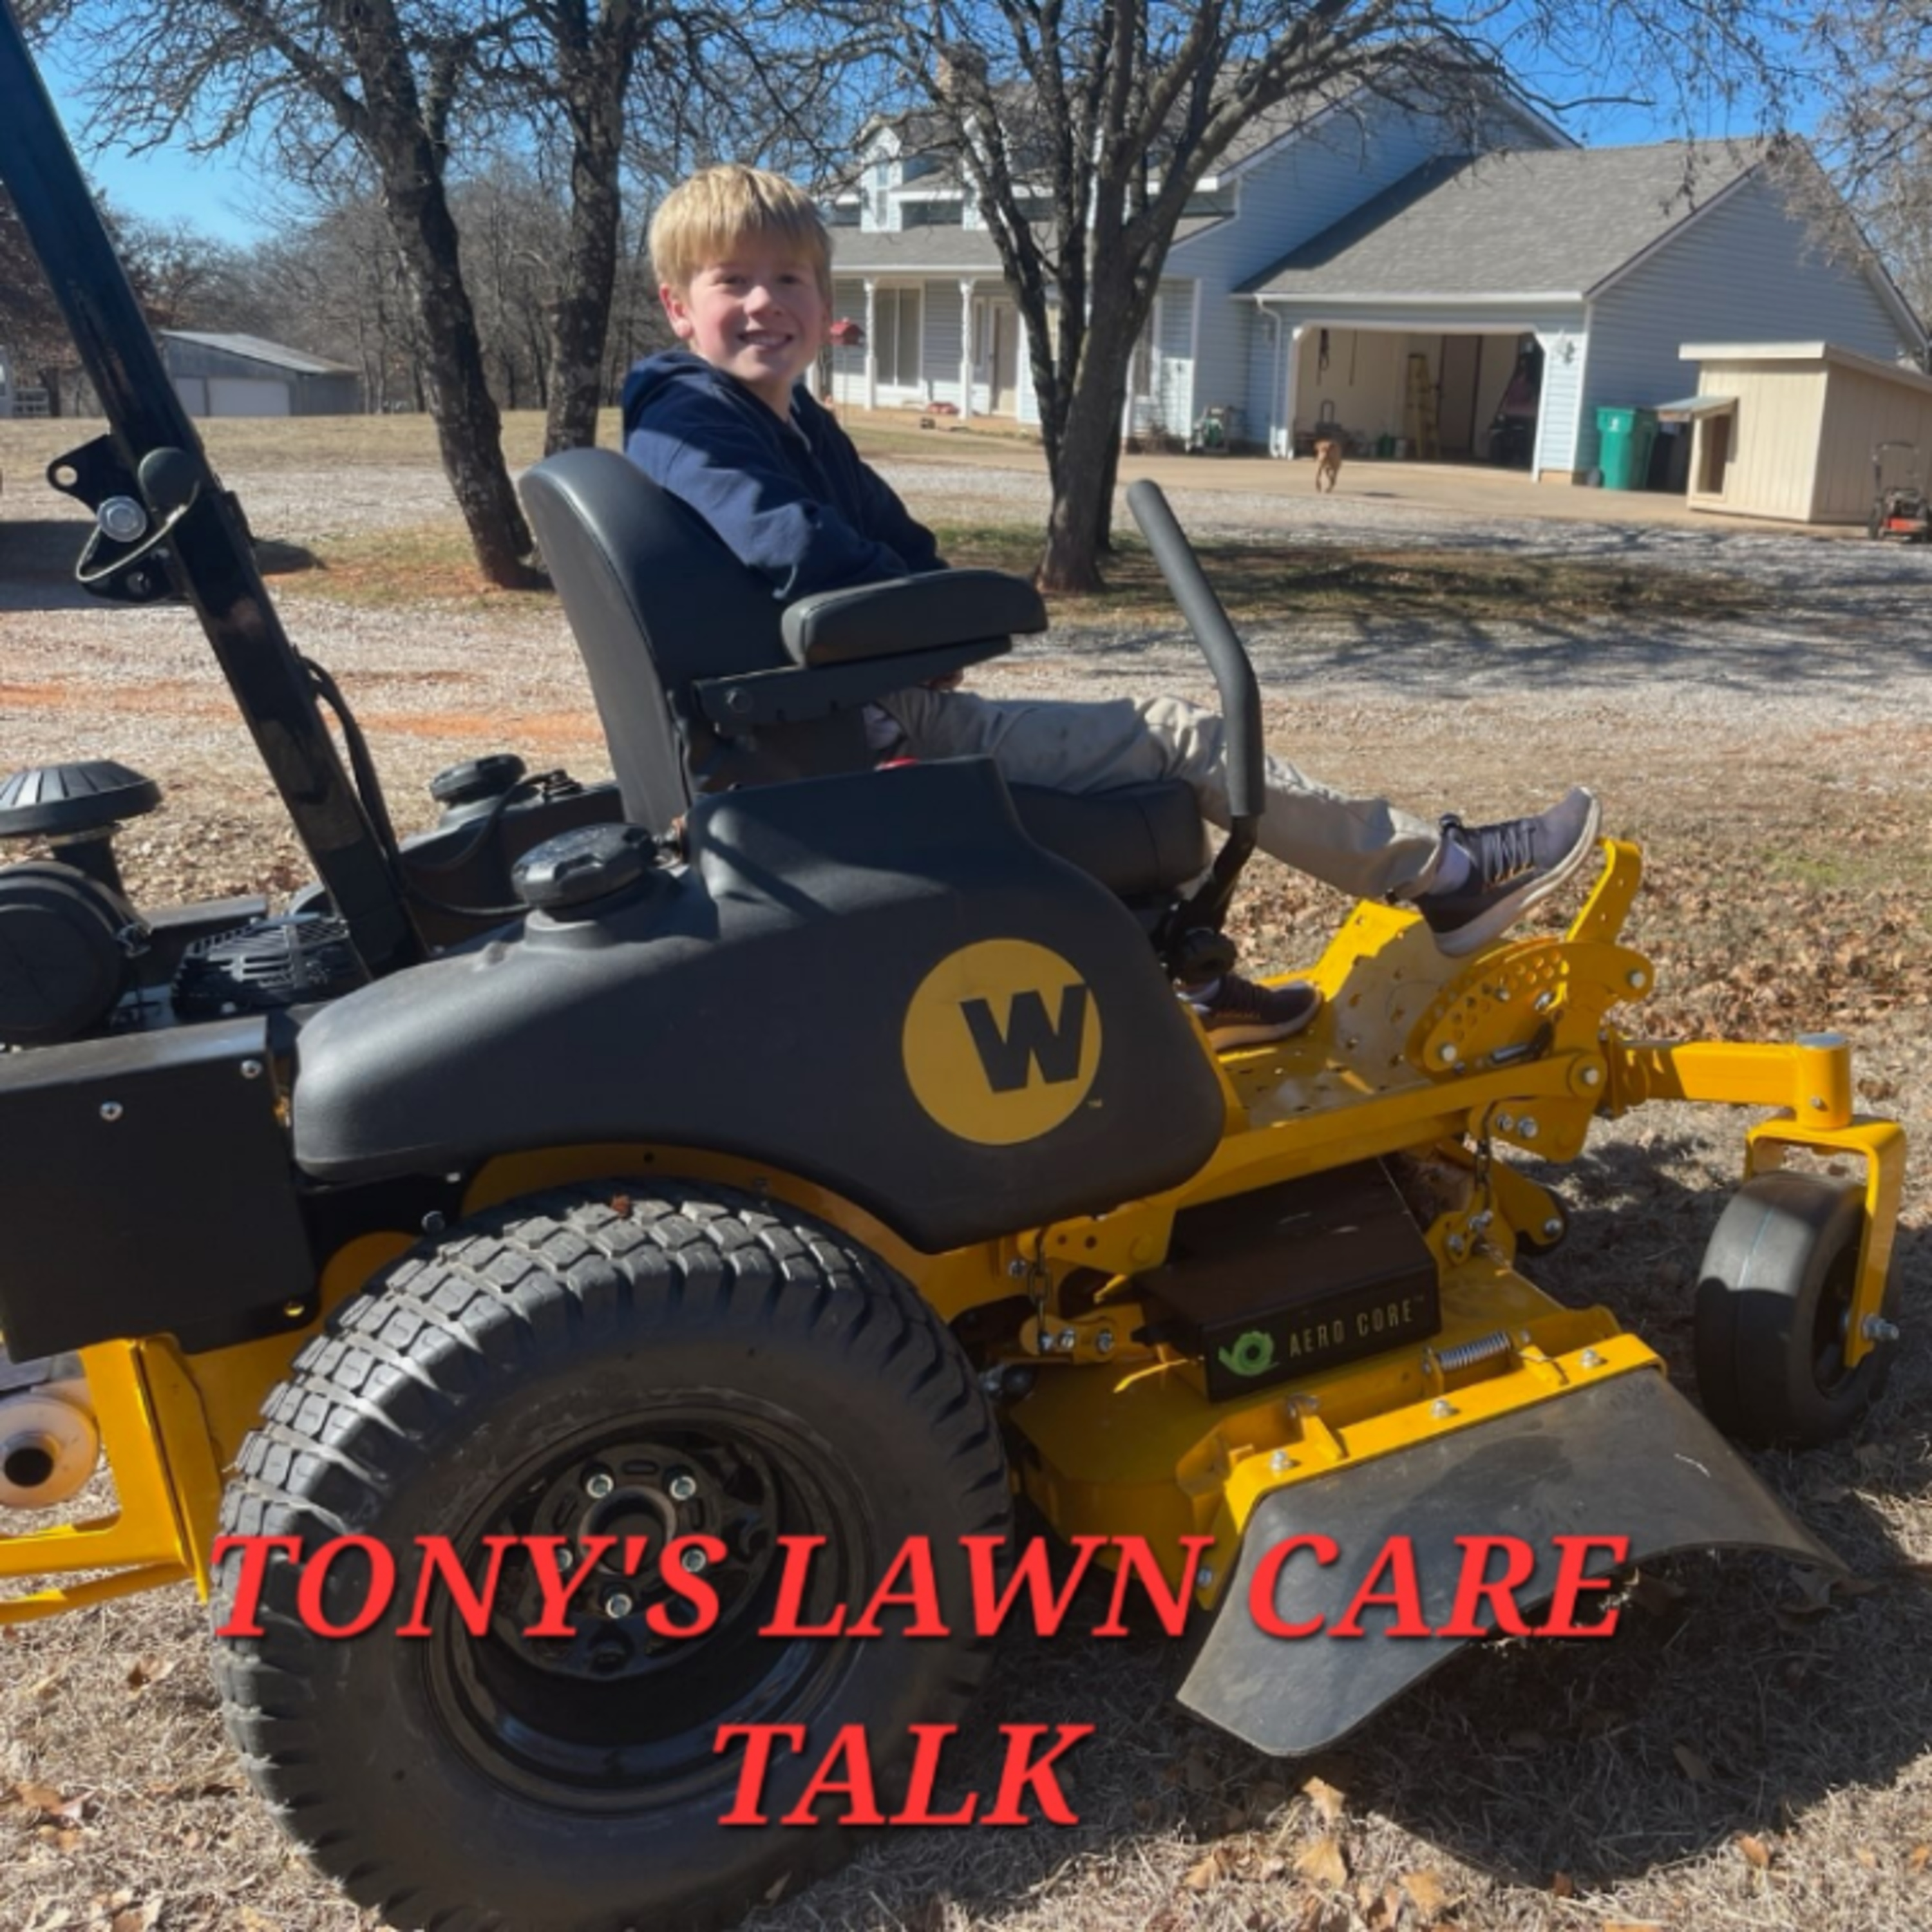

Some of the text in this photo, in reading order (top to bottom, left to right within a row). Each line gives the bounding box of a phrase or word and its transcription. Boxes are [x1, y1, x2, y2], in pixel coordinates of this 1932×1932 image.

[958, 983, 1088, 1094] W
[1289, 1300, 1412, 1358] AERO CORE
